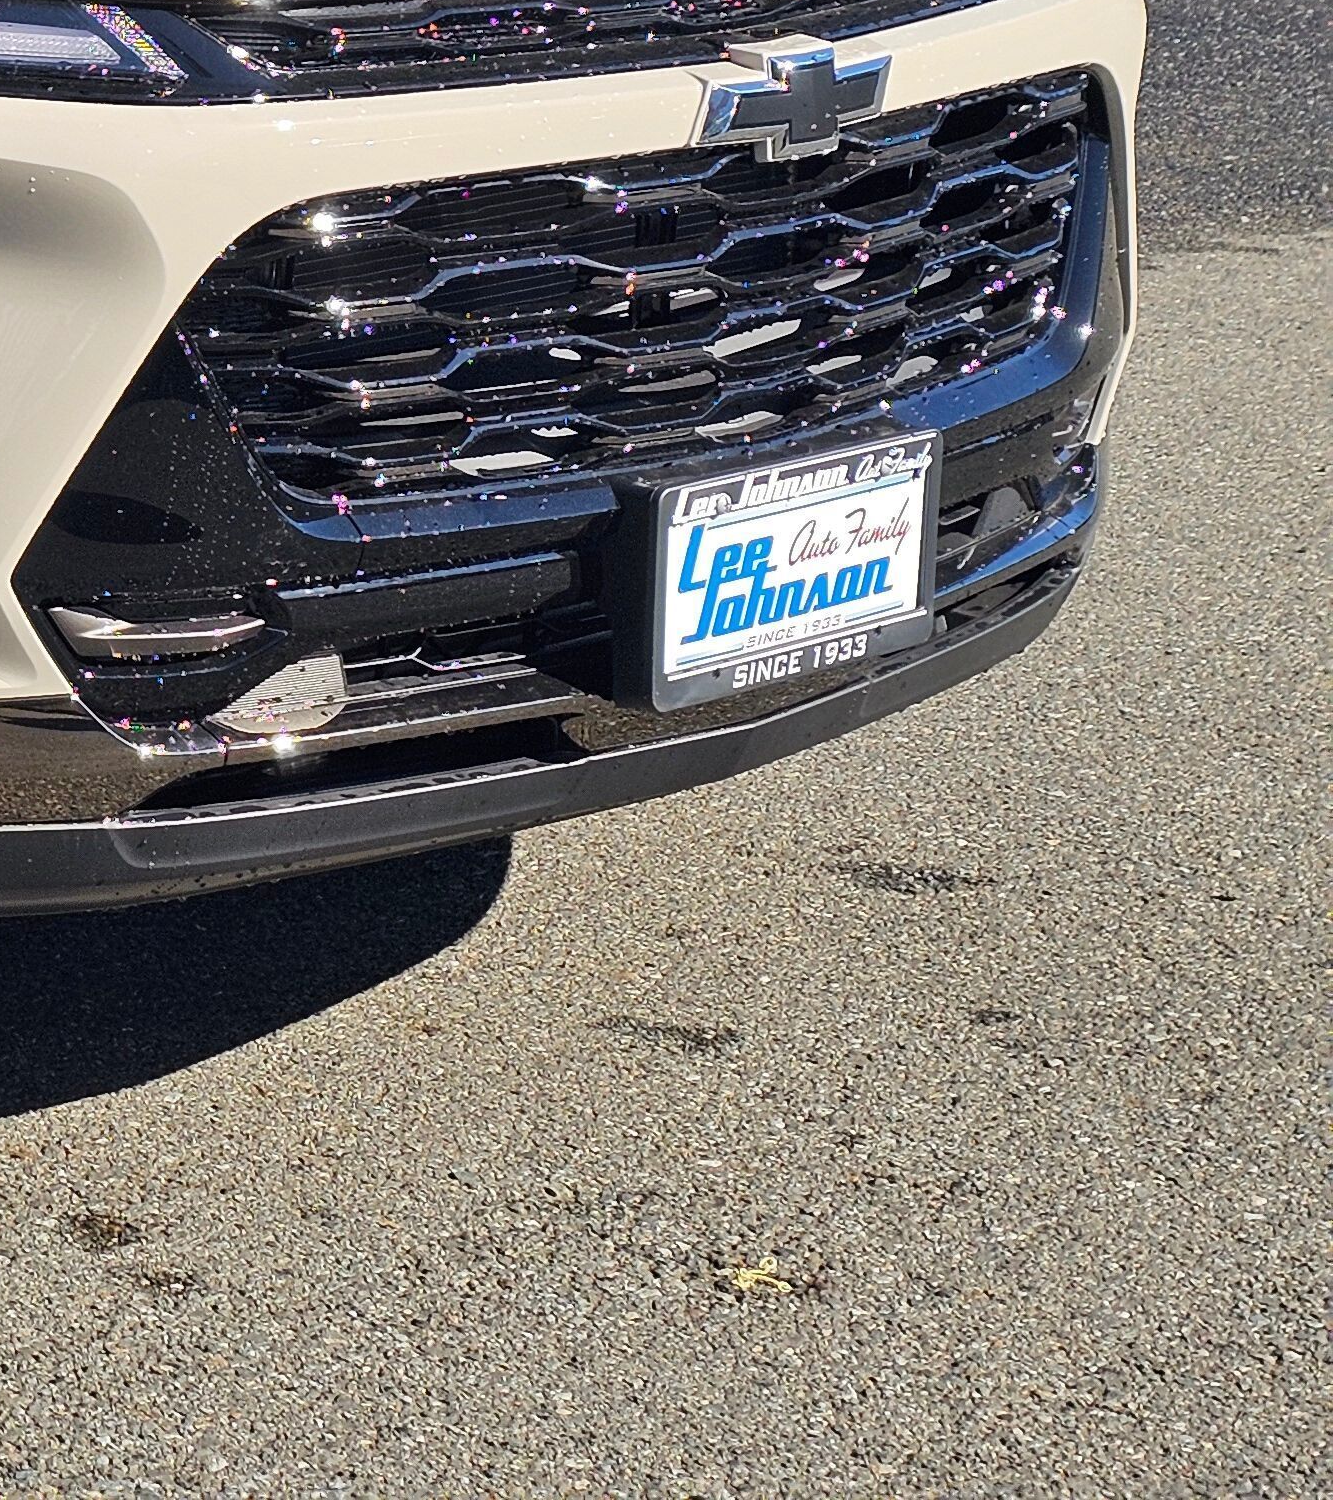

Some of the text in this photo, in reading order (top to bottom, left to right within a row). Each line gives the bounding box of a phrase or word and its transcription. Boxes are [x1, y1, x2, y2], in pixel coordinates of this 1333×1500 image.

[730, 464, 849, 511] Johnson
[678, 524, 774, 593] Lee
[788, 497, 911, 566] Auto Family
[680, 555, 893, 645] Johnson
[745, 614, 841, 648] SINCE 1933
[733, 633, 868, 689] SINCE 1933
